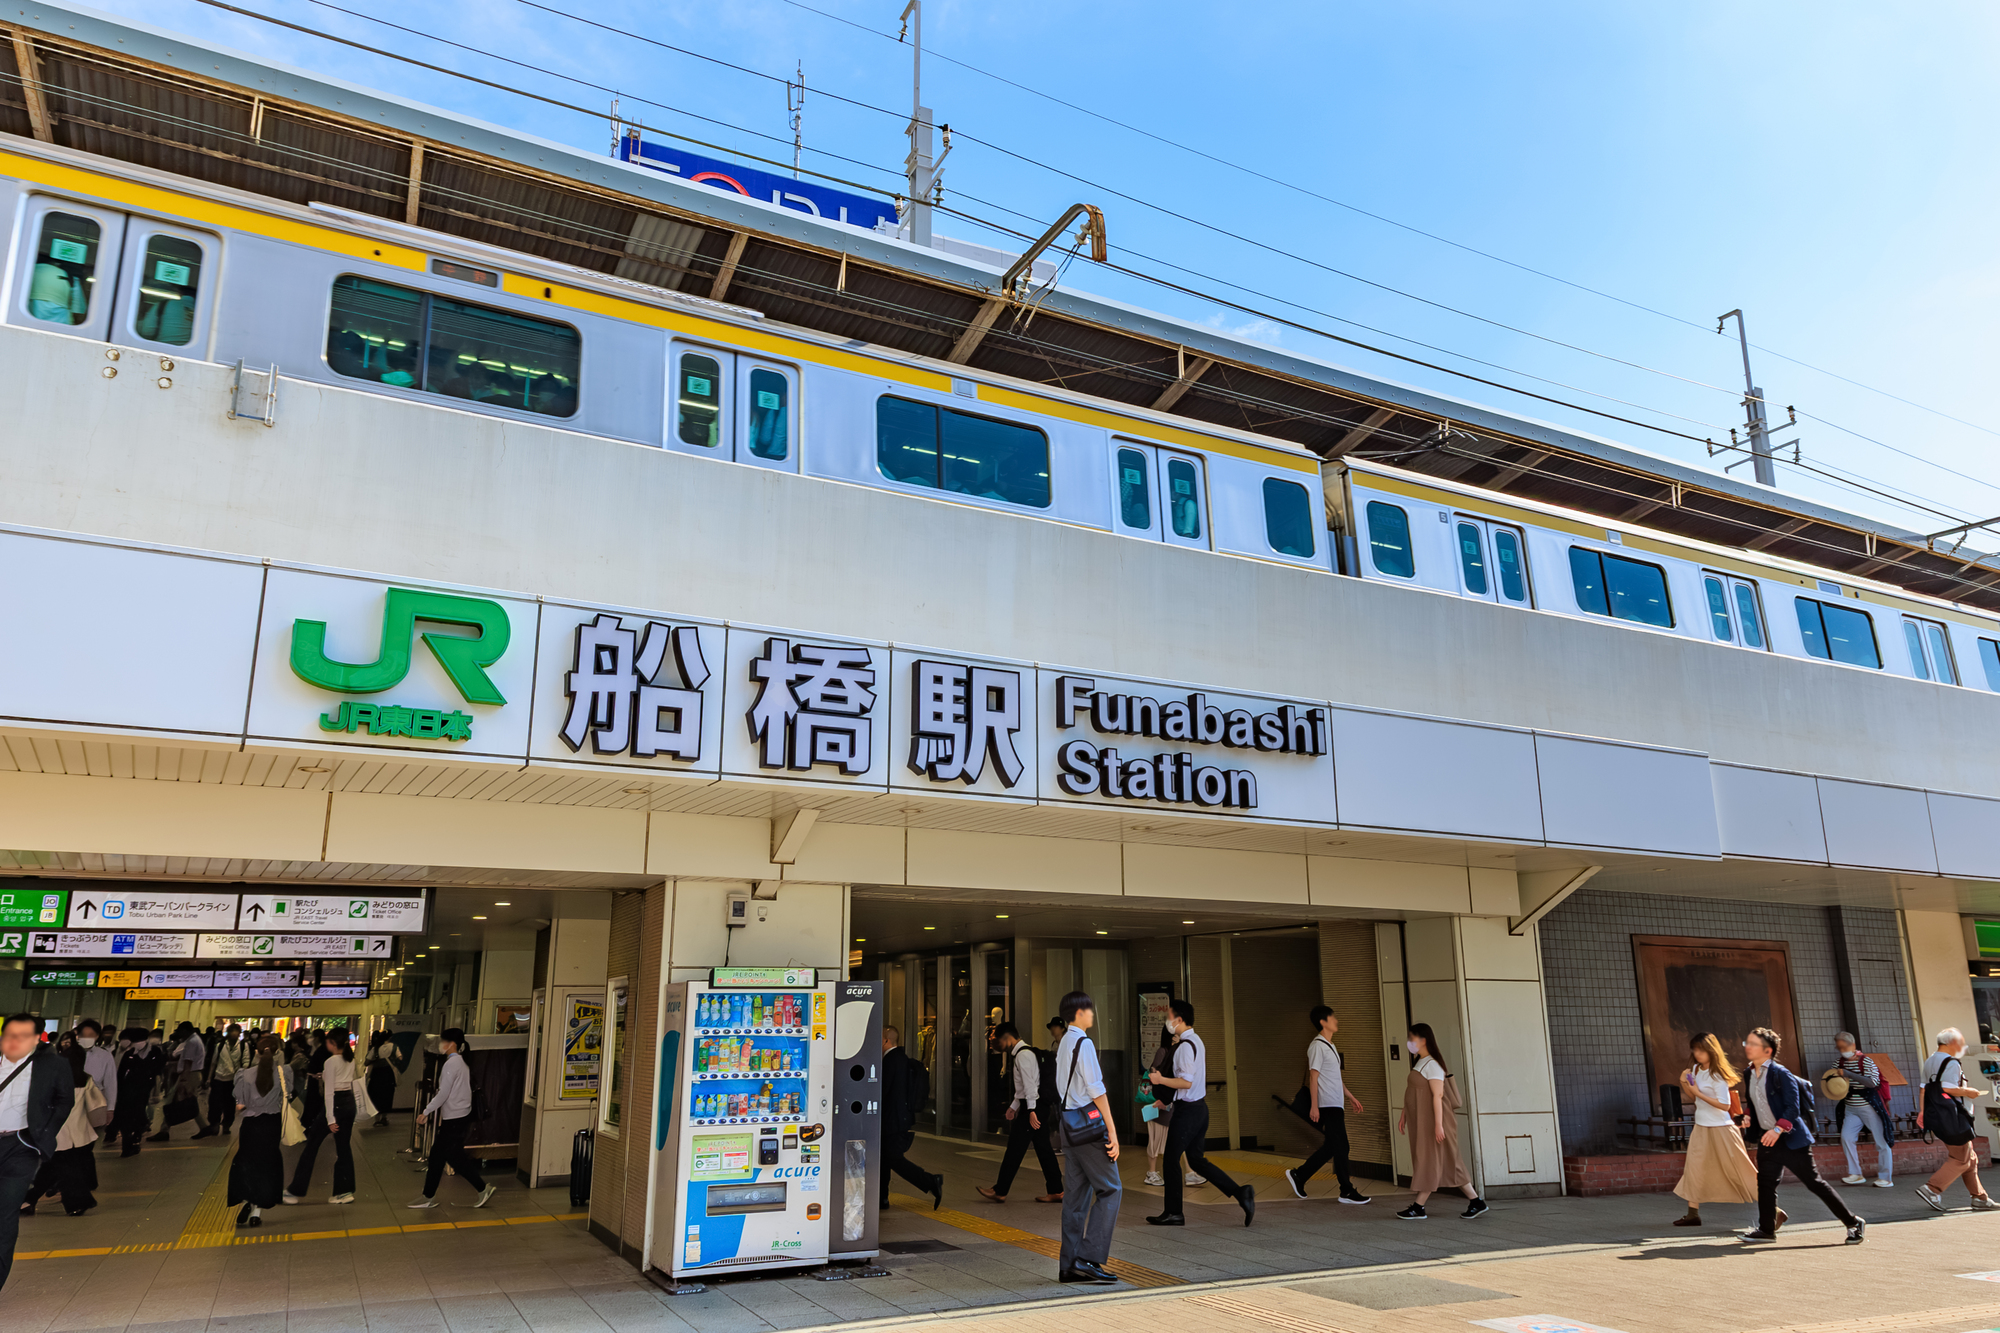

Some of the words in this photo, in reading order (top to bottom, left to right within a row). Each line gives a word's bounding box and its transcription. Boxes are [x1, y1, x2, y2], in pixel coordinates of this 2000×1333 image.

[290, 587, 511, 706] JR
[558, 612, 1025, 788] 船橋駅
[319, 700, 474, 741] JR東日本
[1056, 675, 1328, 757] Funabashi
[1057, 739, 1259, 809] Station
[106, 905, 121, 914] TD
[372, 901, 419, 909] みどりの窓口
[61, 934, 108, 942] きっぷうりば
[205, 935, 251, 943] みどりの窓口
[773, 1165, 821, 1178] acure
[771, 1239, 802, 1248] JR-Cross
